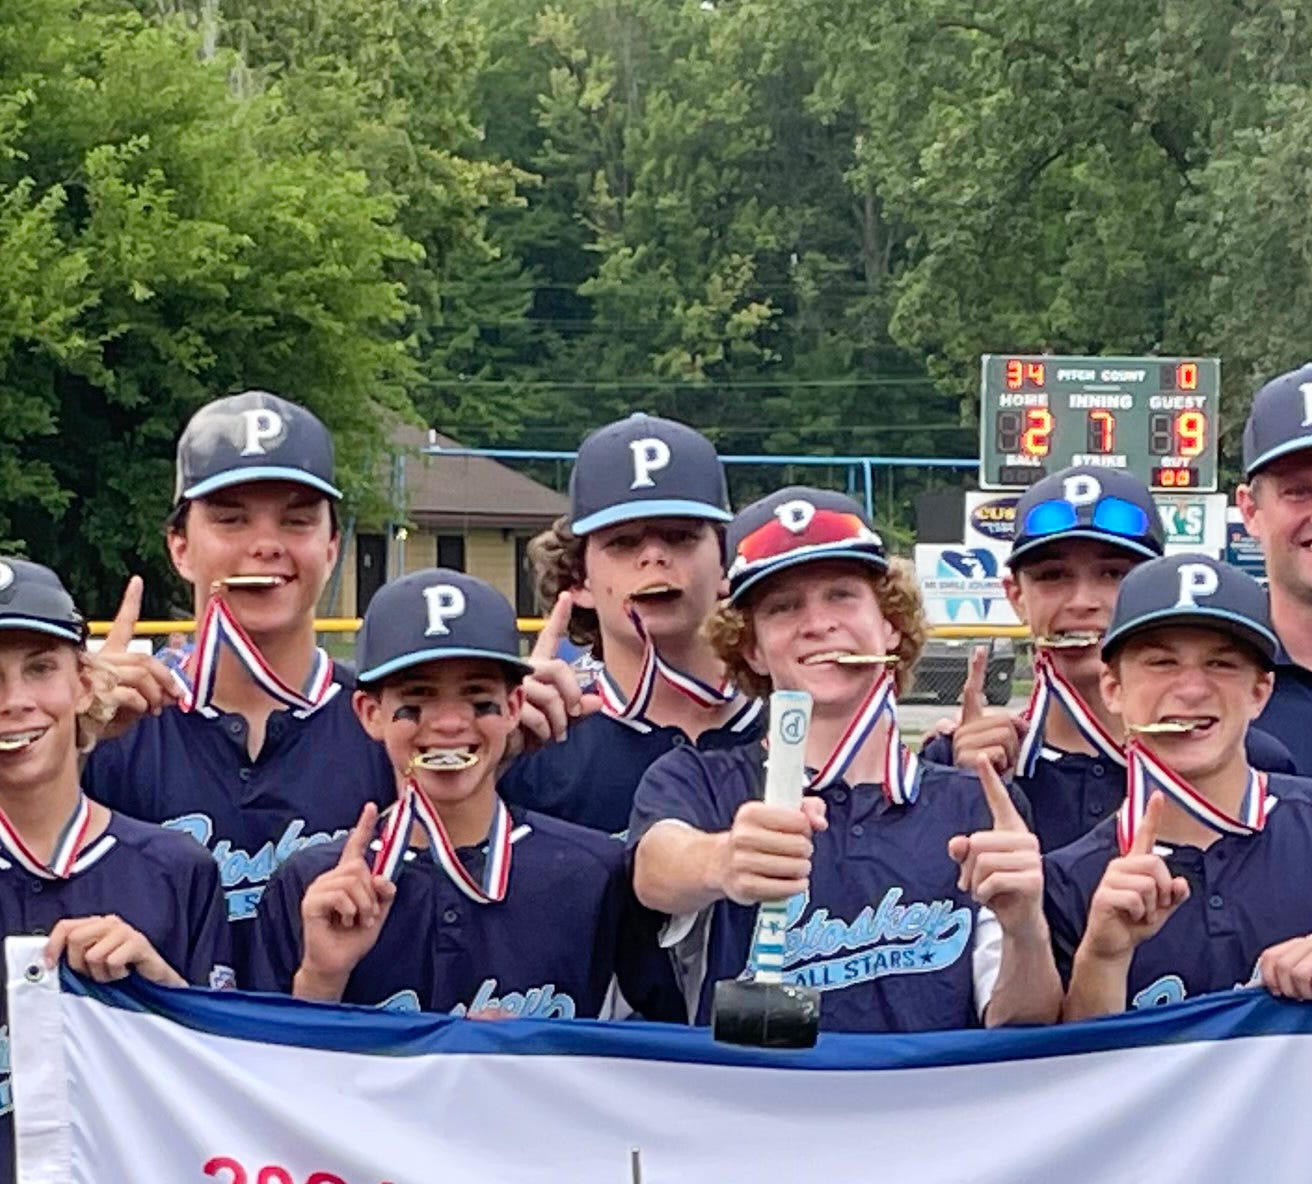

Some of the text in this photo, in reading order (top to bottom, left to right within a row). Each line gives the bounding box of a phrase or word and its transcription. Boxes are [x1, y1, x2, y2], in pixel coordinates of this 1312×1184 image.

[1005, 359, 1046, 390] 34
[1056, 368, 1147, 383] PITCH COUNT
[1176, 361, 1199, 391] 0
[999, 393, 1049, 408] HOME
[1068, 394, 1134, 409] INNING
[1149, 395, 1207, 410] GUEST
[239, 407, 284, 457] P
[1022, 408, 1055, 456] 2
[1088, 409, 1116, 455] 7
[1174, 410, 1208, 457] 9
[629, 438, 671, 490] P
[1005, 454, 1042, 467] BALL
[1071, 454, 1128, 468] STRIKE
[1160, 456, 1191, 468] OUT
[1063, 474, 1102, 506] P
[1177, 563, 1219, 609] P
[422, 583, 466, 637] P
[795, 950, 916, 987] ALL STARS
